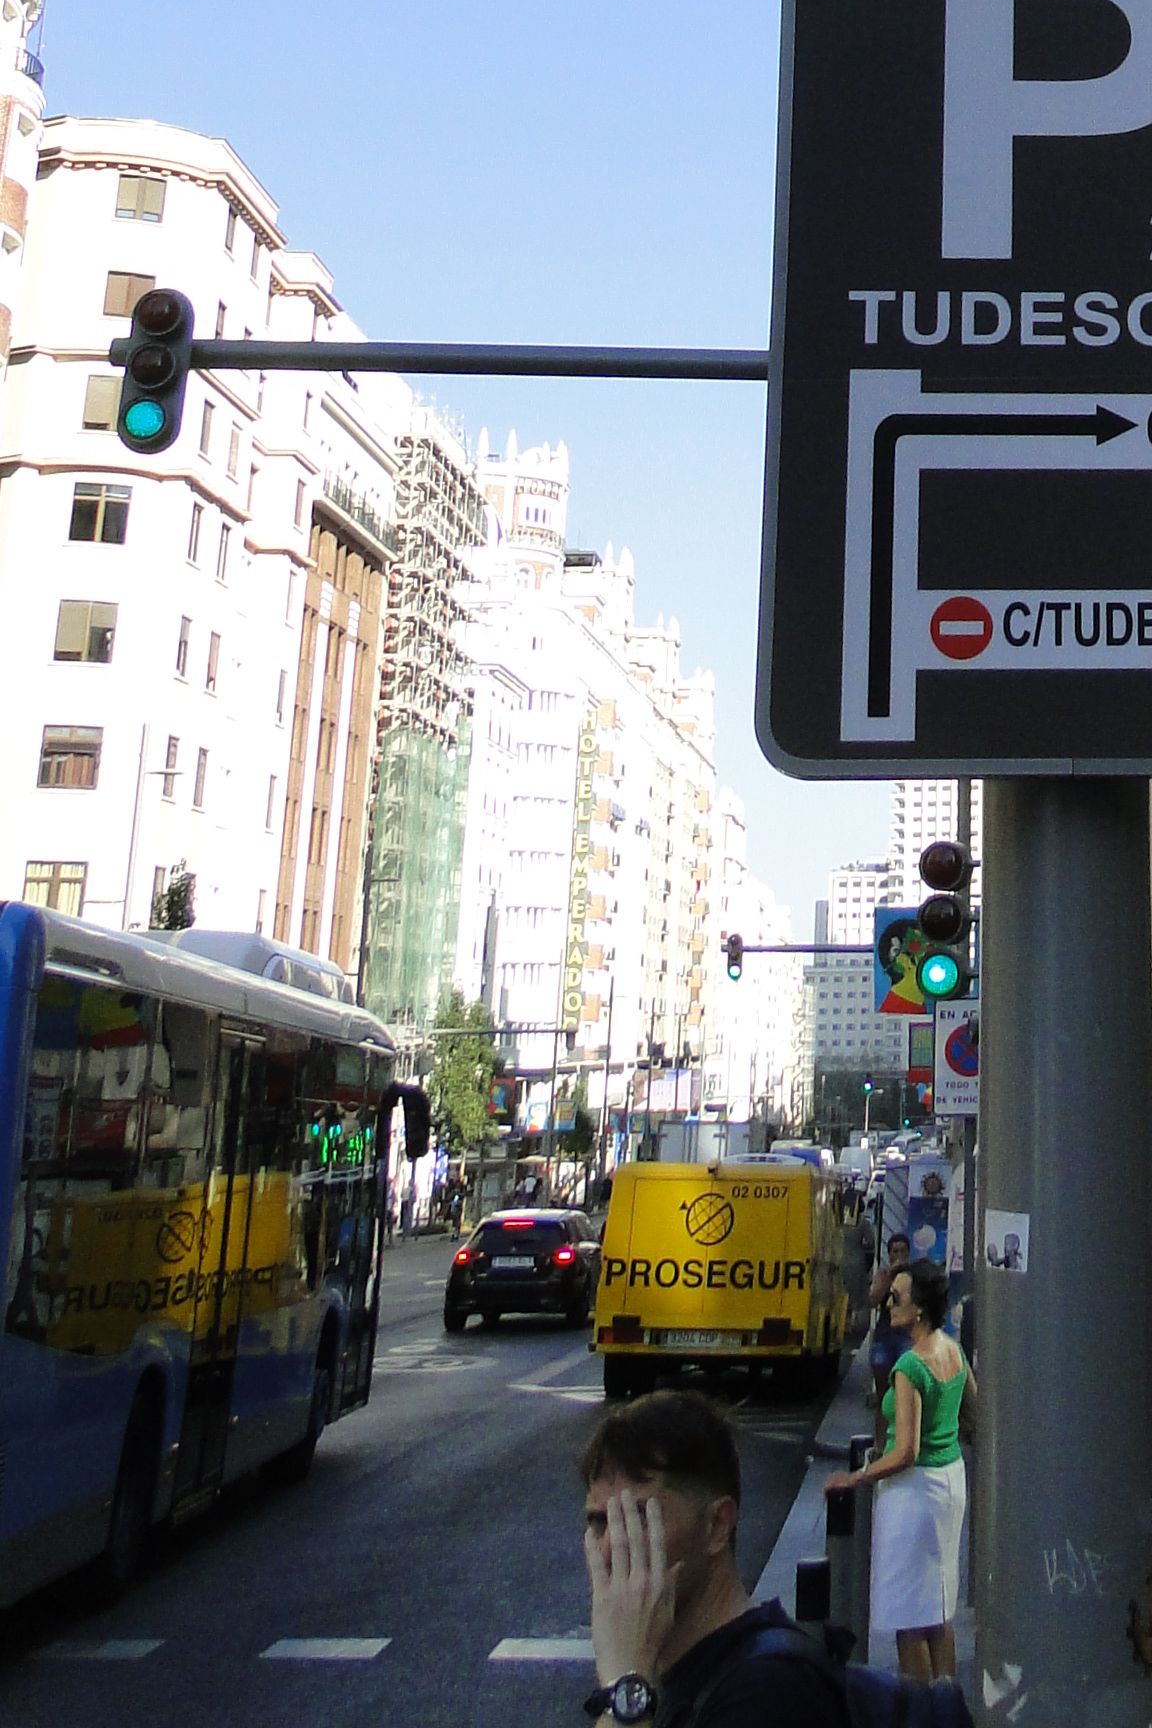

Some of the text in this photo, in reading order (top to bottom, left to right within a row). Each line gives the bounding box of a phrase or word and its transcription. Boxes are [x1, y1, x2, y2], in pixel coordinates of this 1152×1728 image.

[577, 711, 598, 821] HOTEL
[940, 1010, 955, 1019] EN
[945, 1081, 969, 1089] TODO
[732, 1186, 789, 1199] 02 0307
[604, 1258, 808, 1289] PROSEGUR
